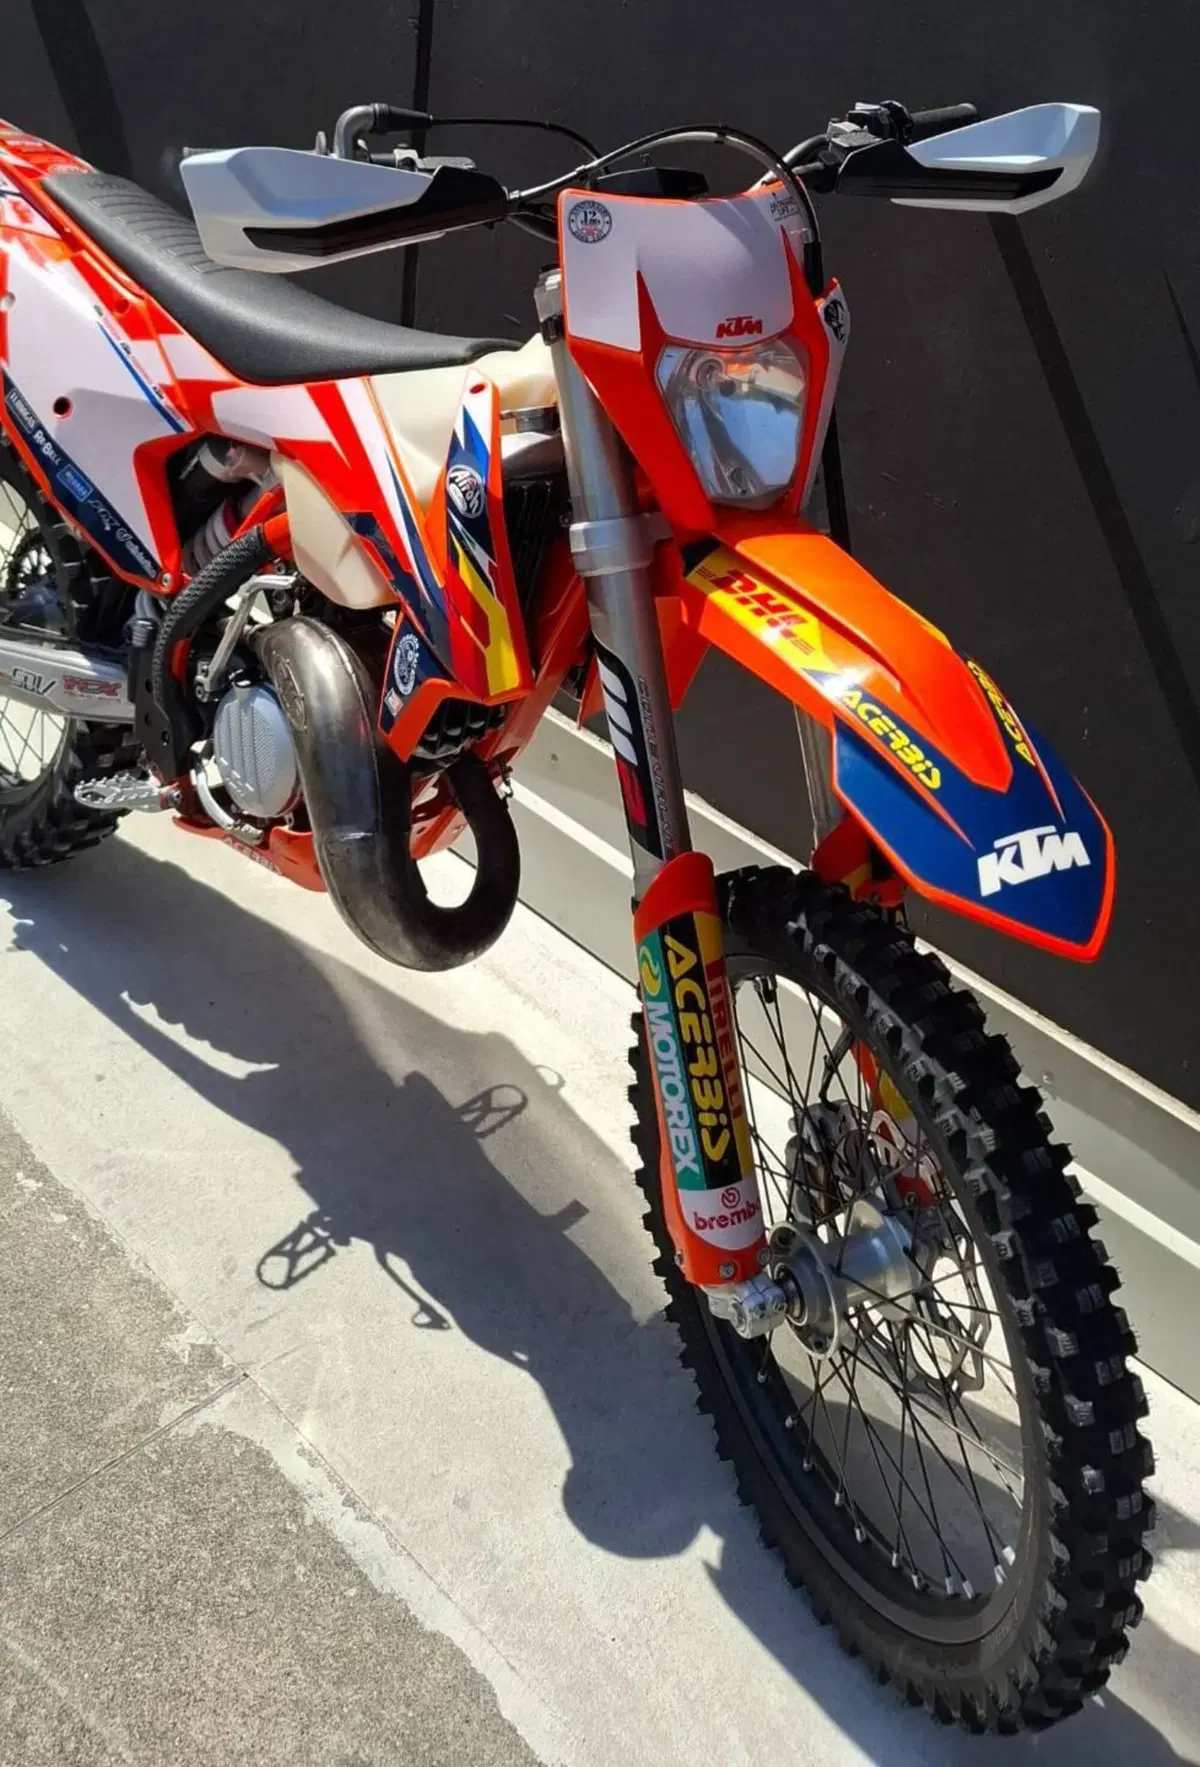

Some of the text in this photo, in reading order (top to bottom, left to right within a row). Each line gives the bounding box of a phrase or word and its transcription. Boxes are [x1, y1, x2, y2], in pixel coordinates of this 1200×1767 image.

[716, 316, 763, 338] KTM
[711, 567, 807, 638] DHL
[842, 690, 942, 790] ACERBIS
[978, 825, 1092, 897] KTM
[645, 1001, 700, 1182] MOTOREX
[665, 935, 732, 1163] ACERBIS
